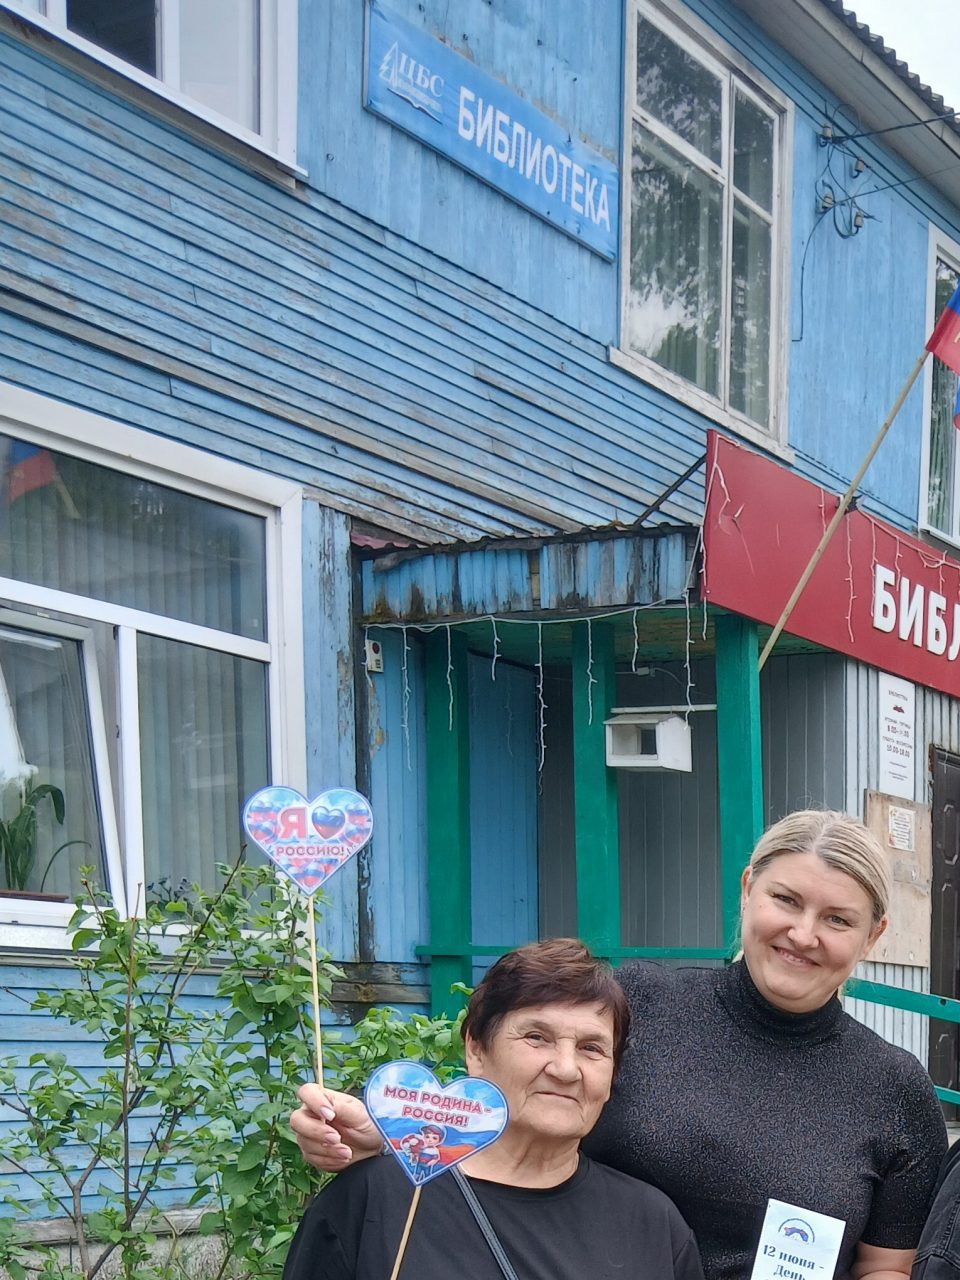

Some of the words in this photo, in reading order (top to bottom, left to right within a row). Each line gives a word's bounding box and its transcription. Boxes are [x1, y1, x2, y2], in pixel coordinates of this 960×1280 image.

[399, 52, 445, 98] ЦБС
[457, 85, 611, 233] БИБЛИОТЕКА
[279, 806, 308, 839] Я
[276, 845, 345, 857] РОССИЮ!
[384, 1085, 418, 1102] МОЯ
[421, 1091, 483, 1114] РОДИНА
[402, 1105, 470, 1127] РОССИЯ!
[763, 1244, 776, 1258] 12
[778, 1251, 816, 1270] июня
